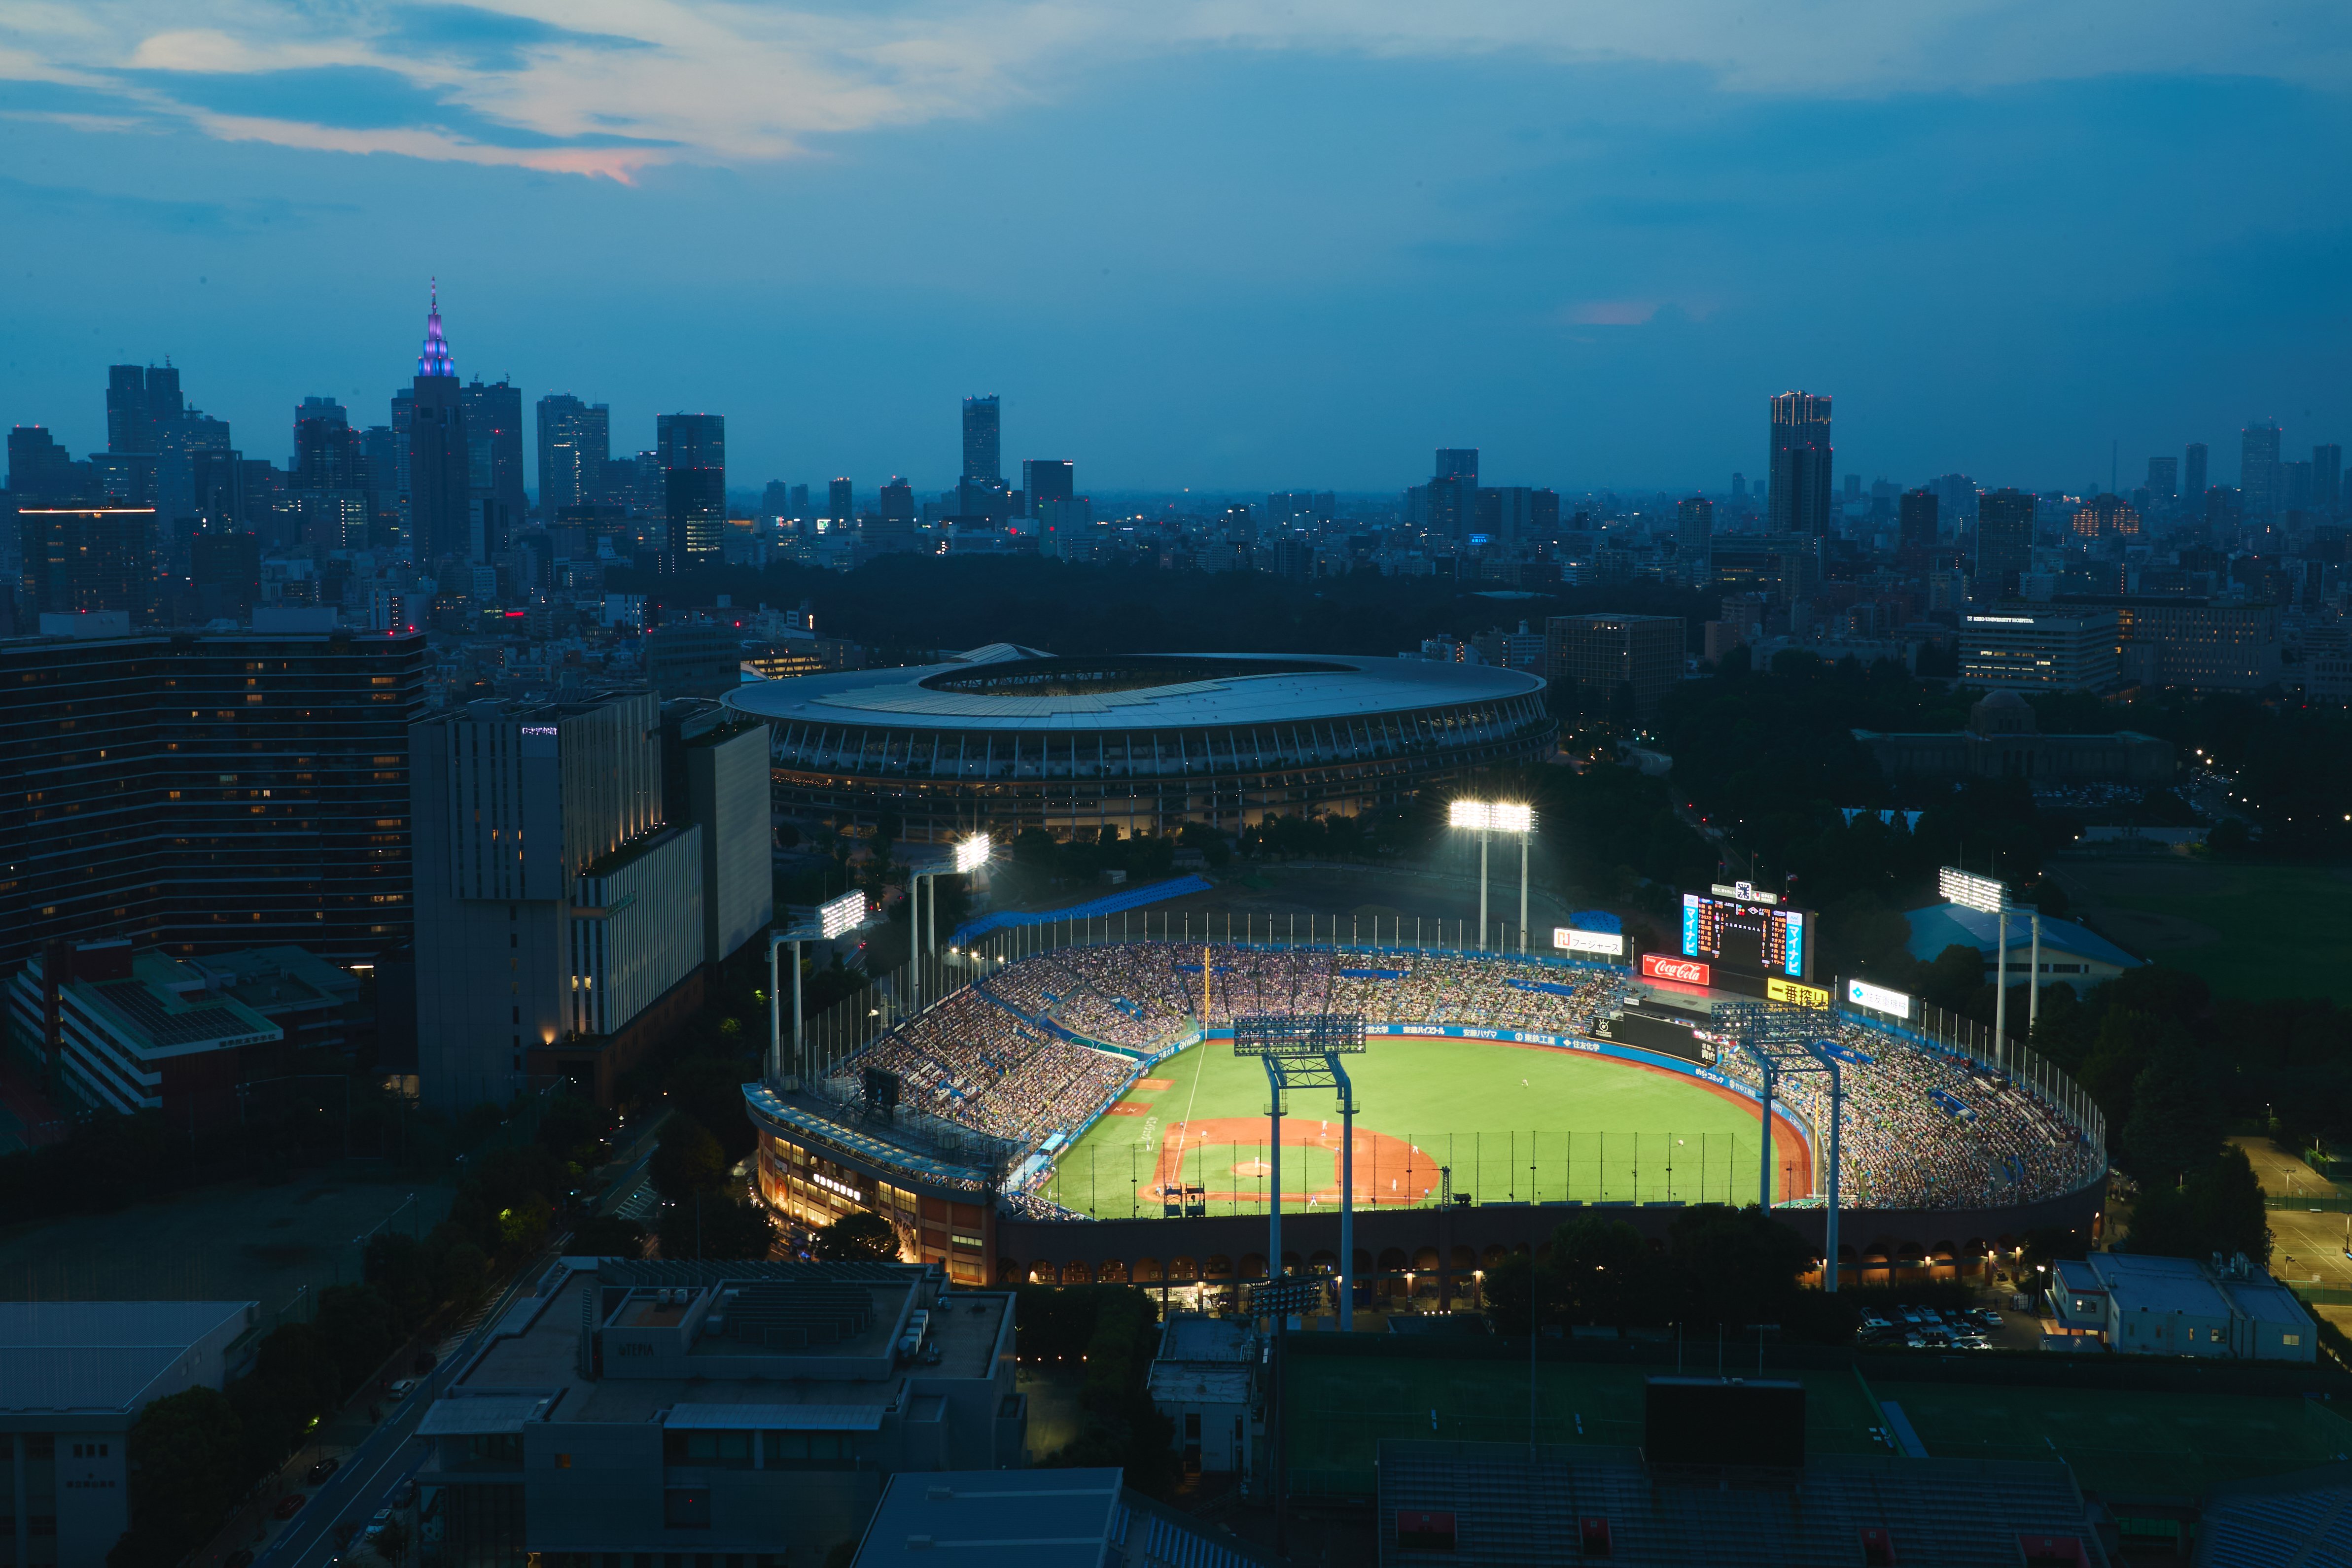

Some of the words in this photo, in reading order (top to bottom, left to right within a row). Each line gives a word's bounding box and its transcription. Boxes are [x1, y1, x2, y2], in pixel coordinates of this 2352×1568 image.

[1686, 908, 1695, 953] マイナビ
[1573, 939, 1619, 952] フージャース
[1789, 926, 1799, 974] マイナビ
[1655, 960, 1701, 980] Coca-Cola
[1867, 991, 1907, 1012] 住友重機械
[1403, 1026, 1444, 1035] 東進ハイスクール
[1463, 1029, 1497, 1039] 安藤ハザマ
[1179, 1034, 1200, 1050] ONWARD
[1524, 1034, 1555, 1045] 東鉄工業
[1573, 1040, 1600, 1051] 住友化学
[1771, 1100, 1782, 1114] ハザマ
[626, 1344, 654, 1356] TEPIA
